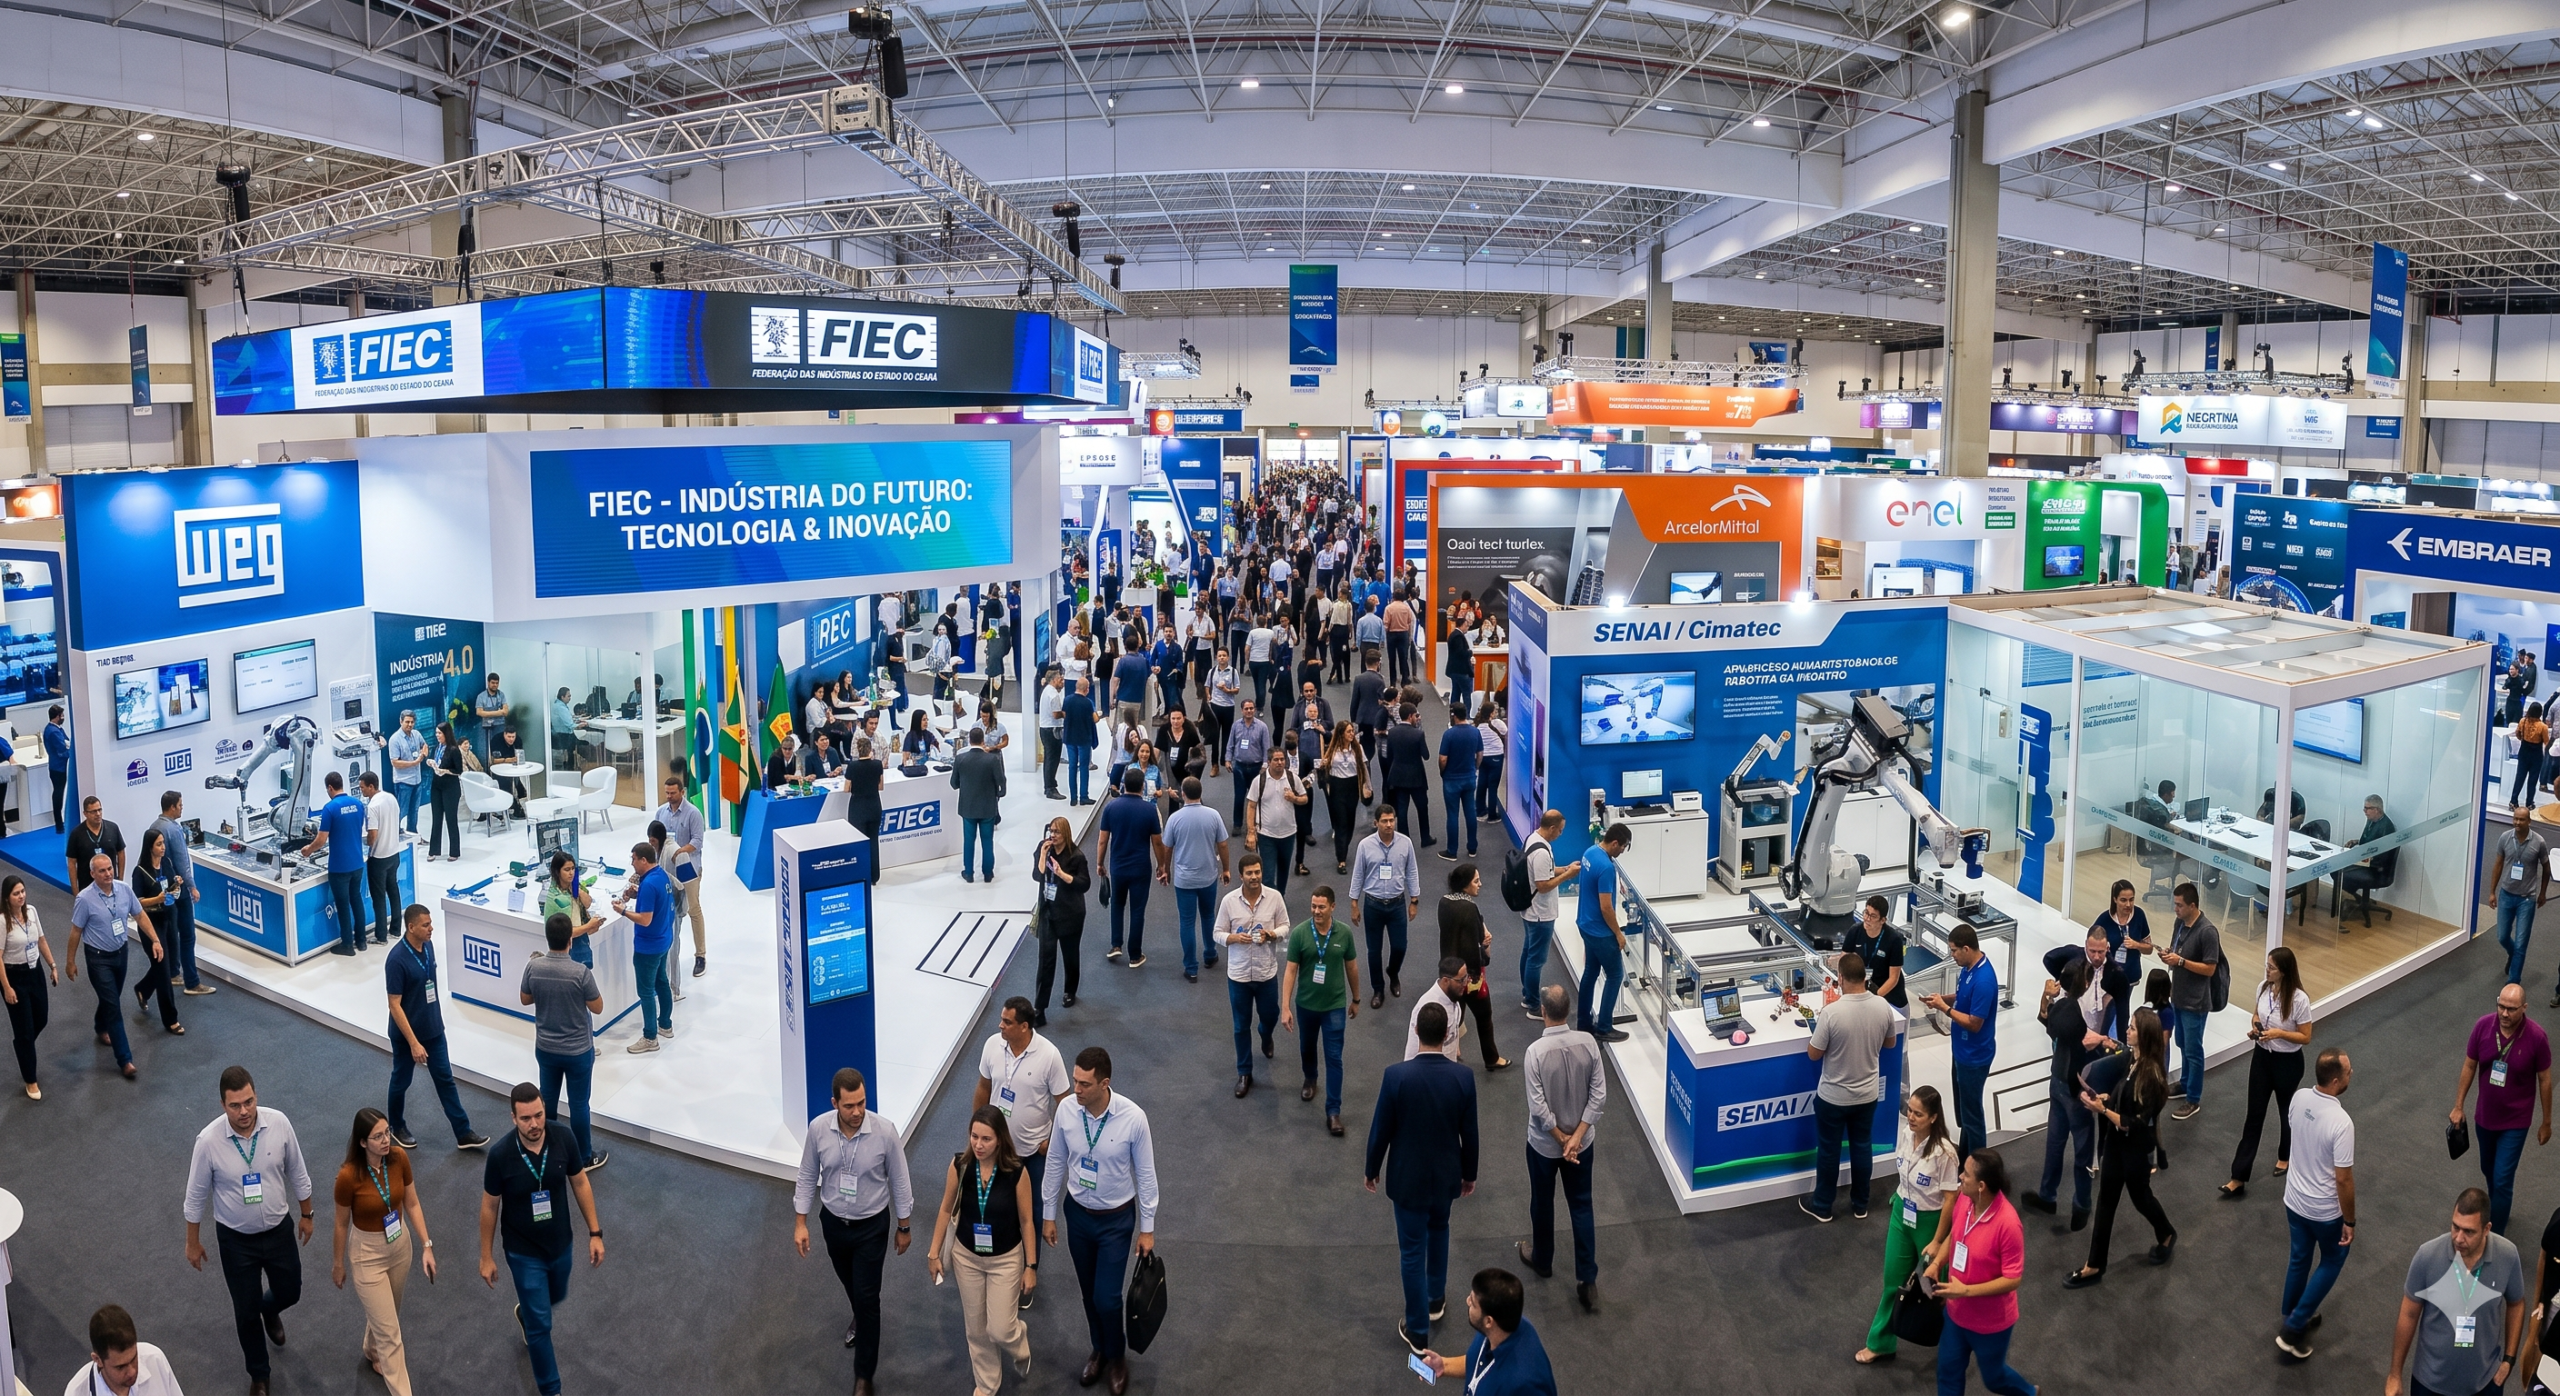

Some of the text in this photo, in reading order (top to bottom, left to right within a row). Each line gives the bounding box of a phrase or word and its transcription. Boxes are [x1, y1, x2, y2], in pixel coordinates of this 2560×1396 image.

[358, 328, 442, 375] FIEC
[820, 319, 926, 360] FIEC
[799, 369, 816, 379] DAS
[862, 371, 873, 380] DO
[874, 371, 902, 381] ESTADO
[903, 372, 913, 381] DO
[589, 489, 652, 518] FIEC
[679, 481, 823, 514] INDÚSTRIA
[830, 483, 864, 507] DO
[872, 478, 971, 505] FUTURO:
[1886, 491, 1963, 527] enel
[620, 504, 950, 550] TECNOLOGIA & INOVAÇÃO
[1663, 519, 1760, 535] ArcelorMittal
[2418, 536, 2552, 567] EMBRAER
[819, 610, 851, 650] REC
[1593, 619, 1782, 643] SENAI / Cimatec
[389, 651, 445, 676] INDÚSTRIA
[883, 805, 935, 832] FIEC
[1724, 1097, 1799, 1127] SENAI
